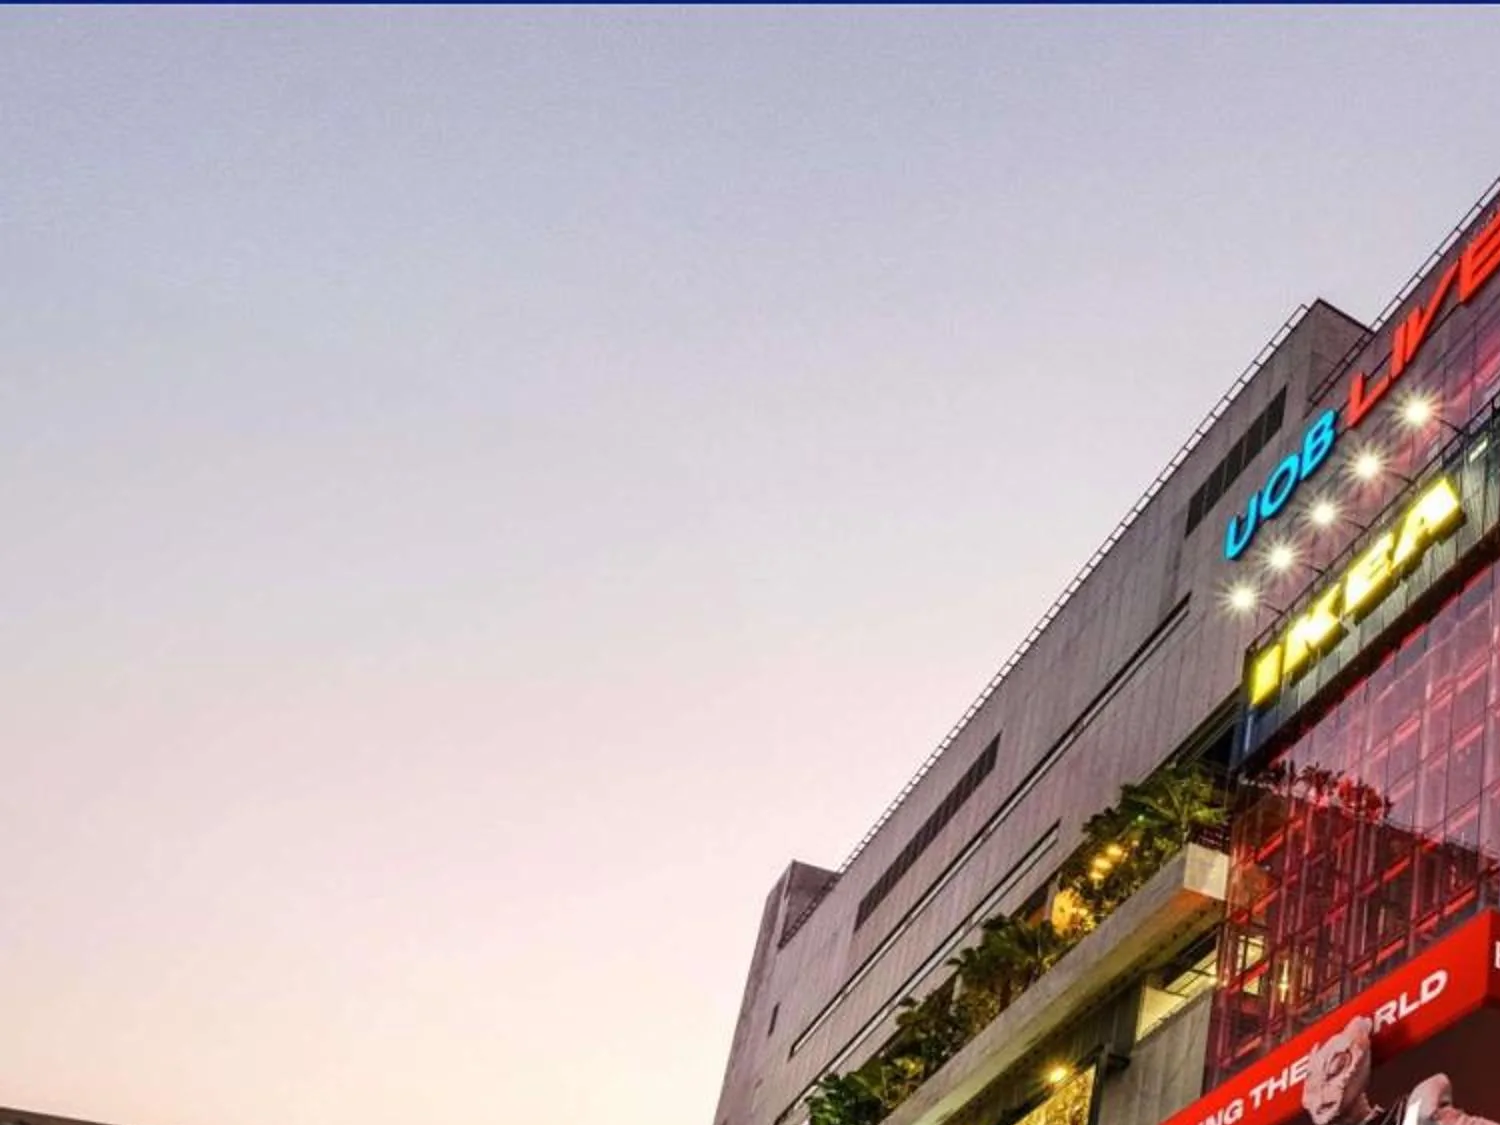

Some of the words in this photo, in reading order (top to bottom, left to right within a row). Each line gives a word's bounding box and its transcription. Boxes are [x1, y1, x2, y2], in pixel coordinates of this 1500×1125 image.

[1225, 408, 1338, 560] UOB
[1250, 477, 1463, 706] IKEA
[1249, 1060, 1308, 1109] THE
